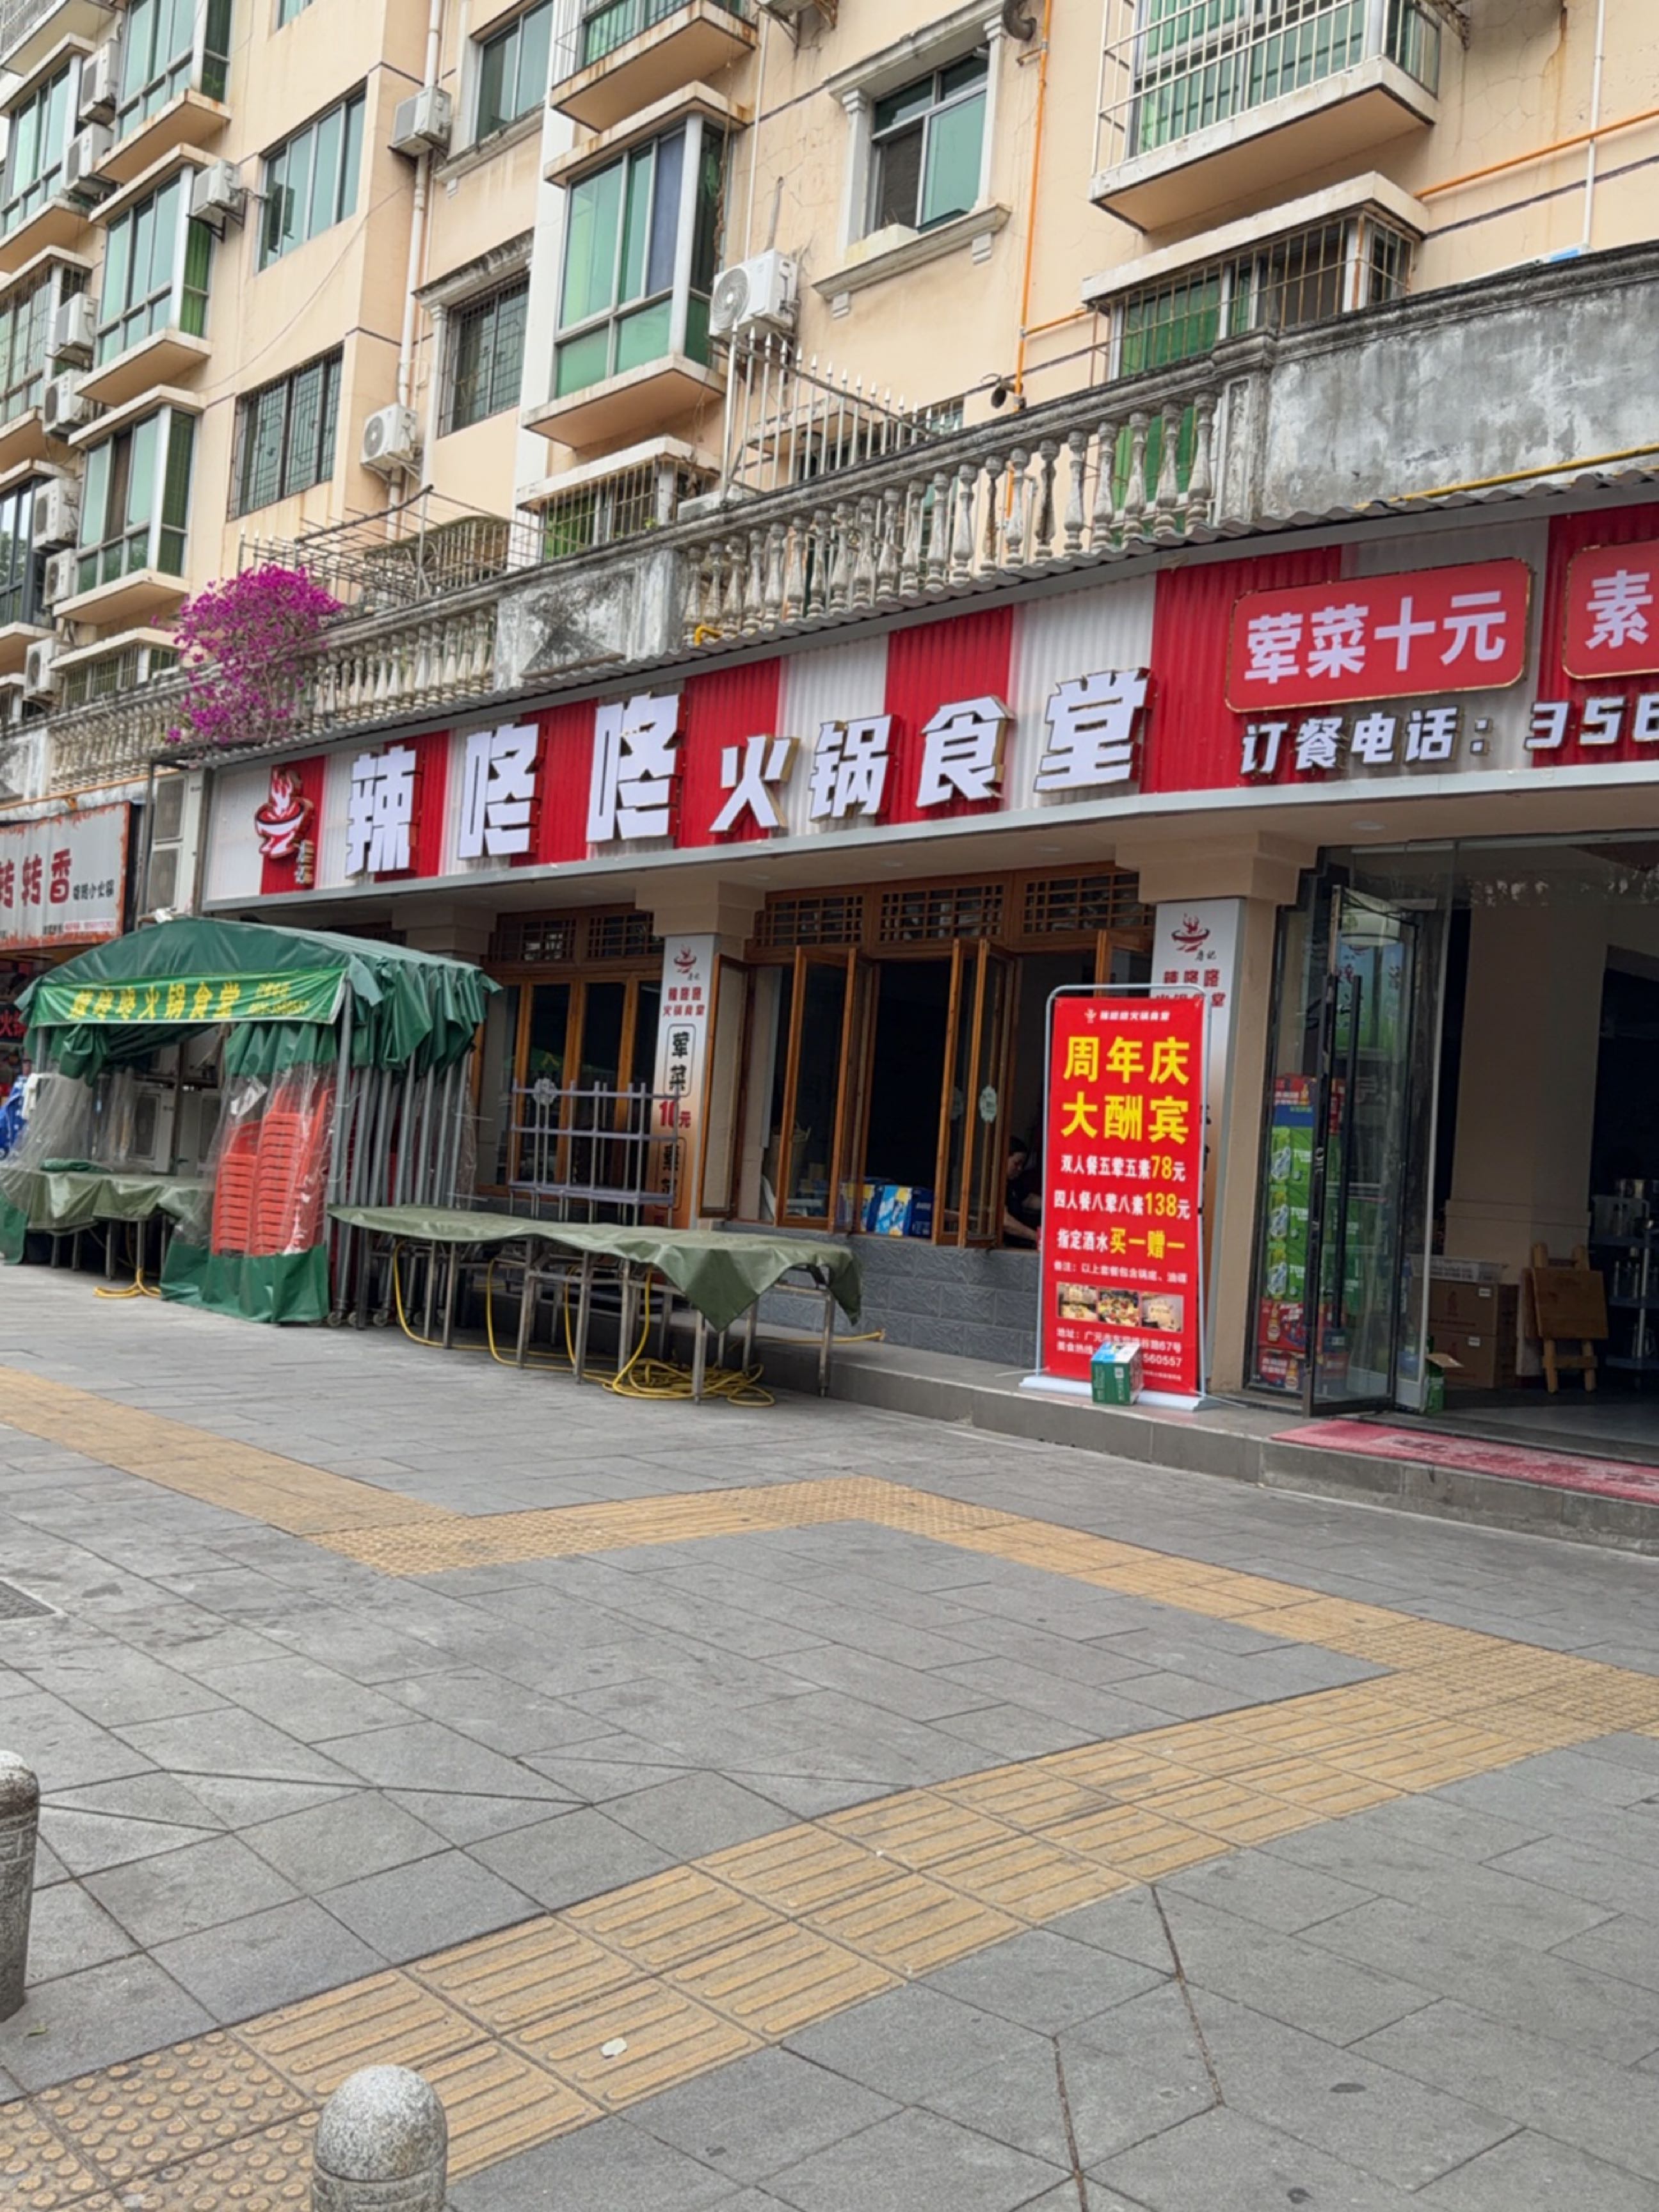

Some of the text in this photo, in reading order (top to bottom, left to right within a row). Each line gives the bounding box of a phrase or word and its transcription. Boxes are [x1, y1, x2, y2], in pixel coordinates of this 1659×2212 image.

[1585, 569, 1654, 650] 素
[1244, 590, 1507, 684] 荤菜十元
[346, 667, 1150, 878] 辣咚咚火锅食堂
[1063, 1035, 1190, 1085] 周年庆
[1061, 1091, 1189, 1144] 大酬宾
[1061, 1154, 1186, 1182] 双人餐五荤五素78元
[1054, 1189, 1191, 1220] 四人餐八荤八素138元
[1057, 1226, 1186, 1260] 指定酒水买一赠一
